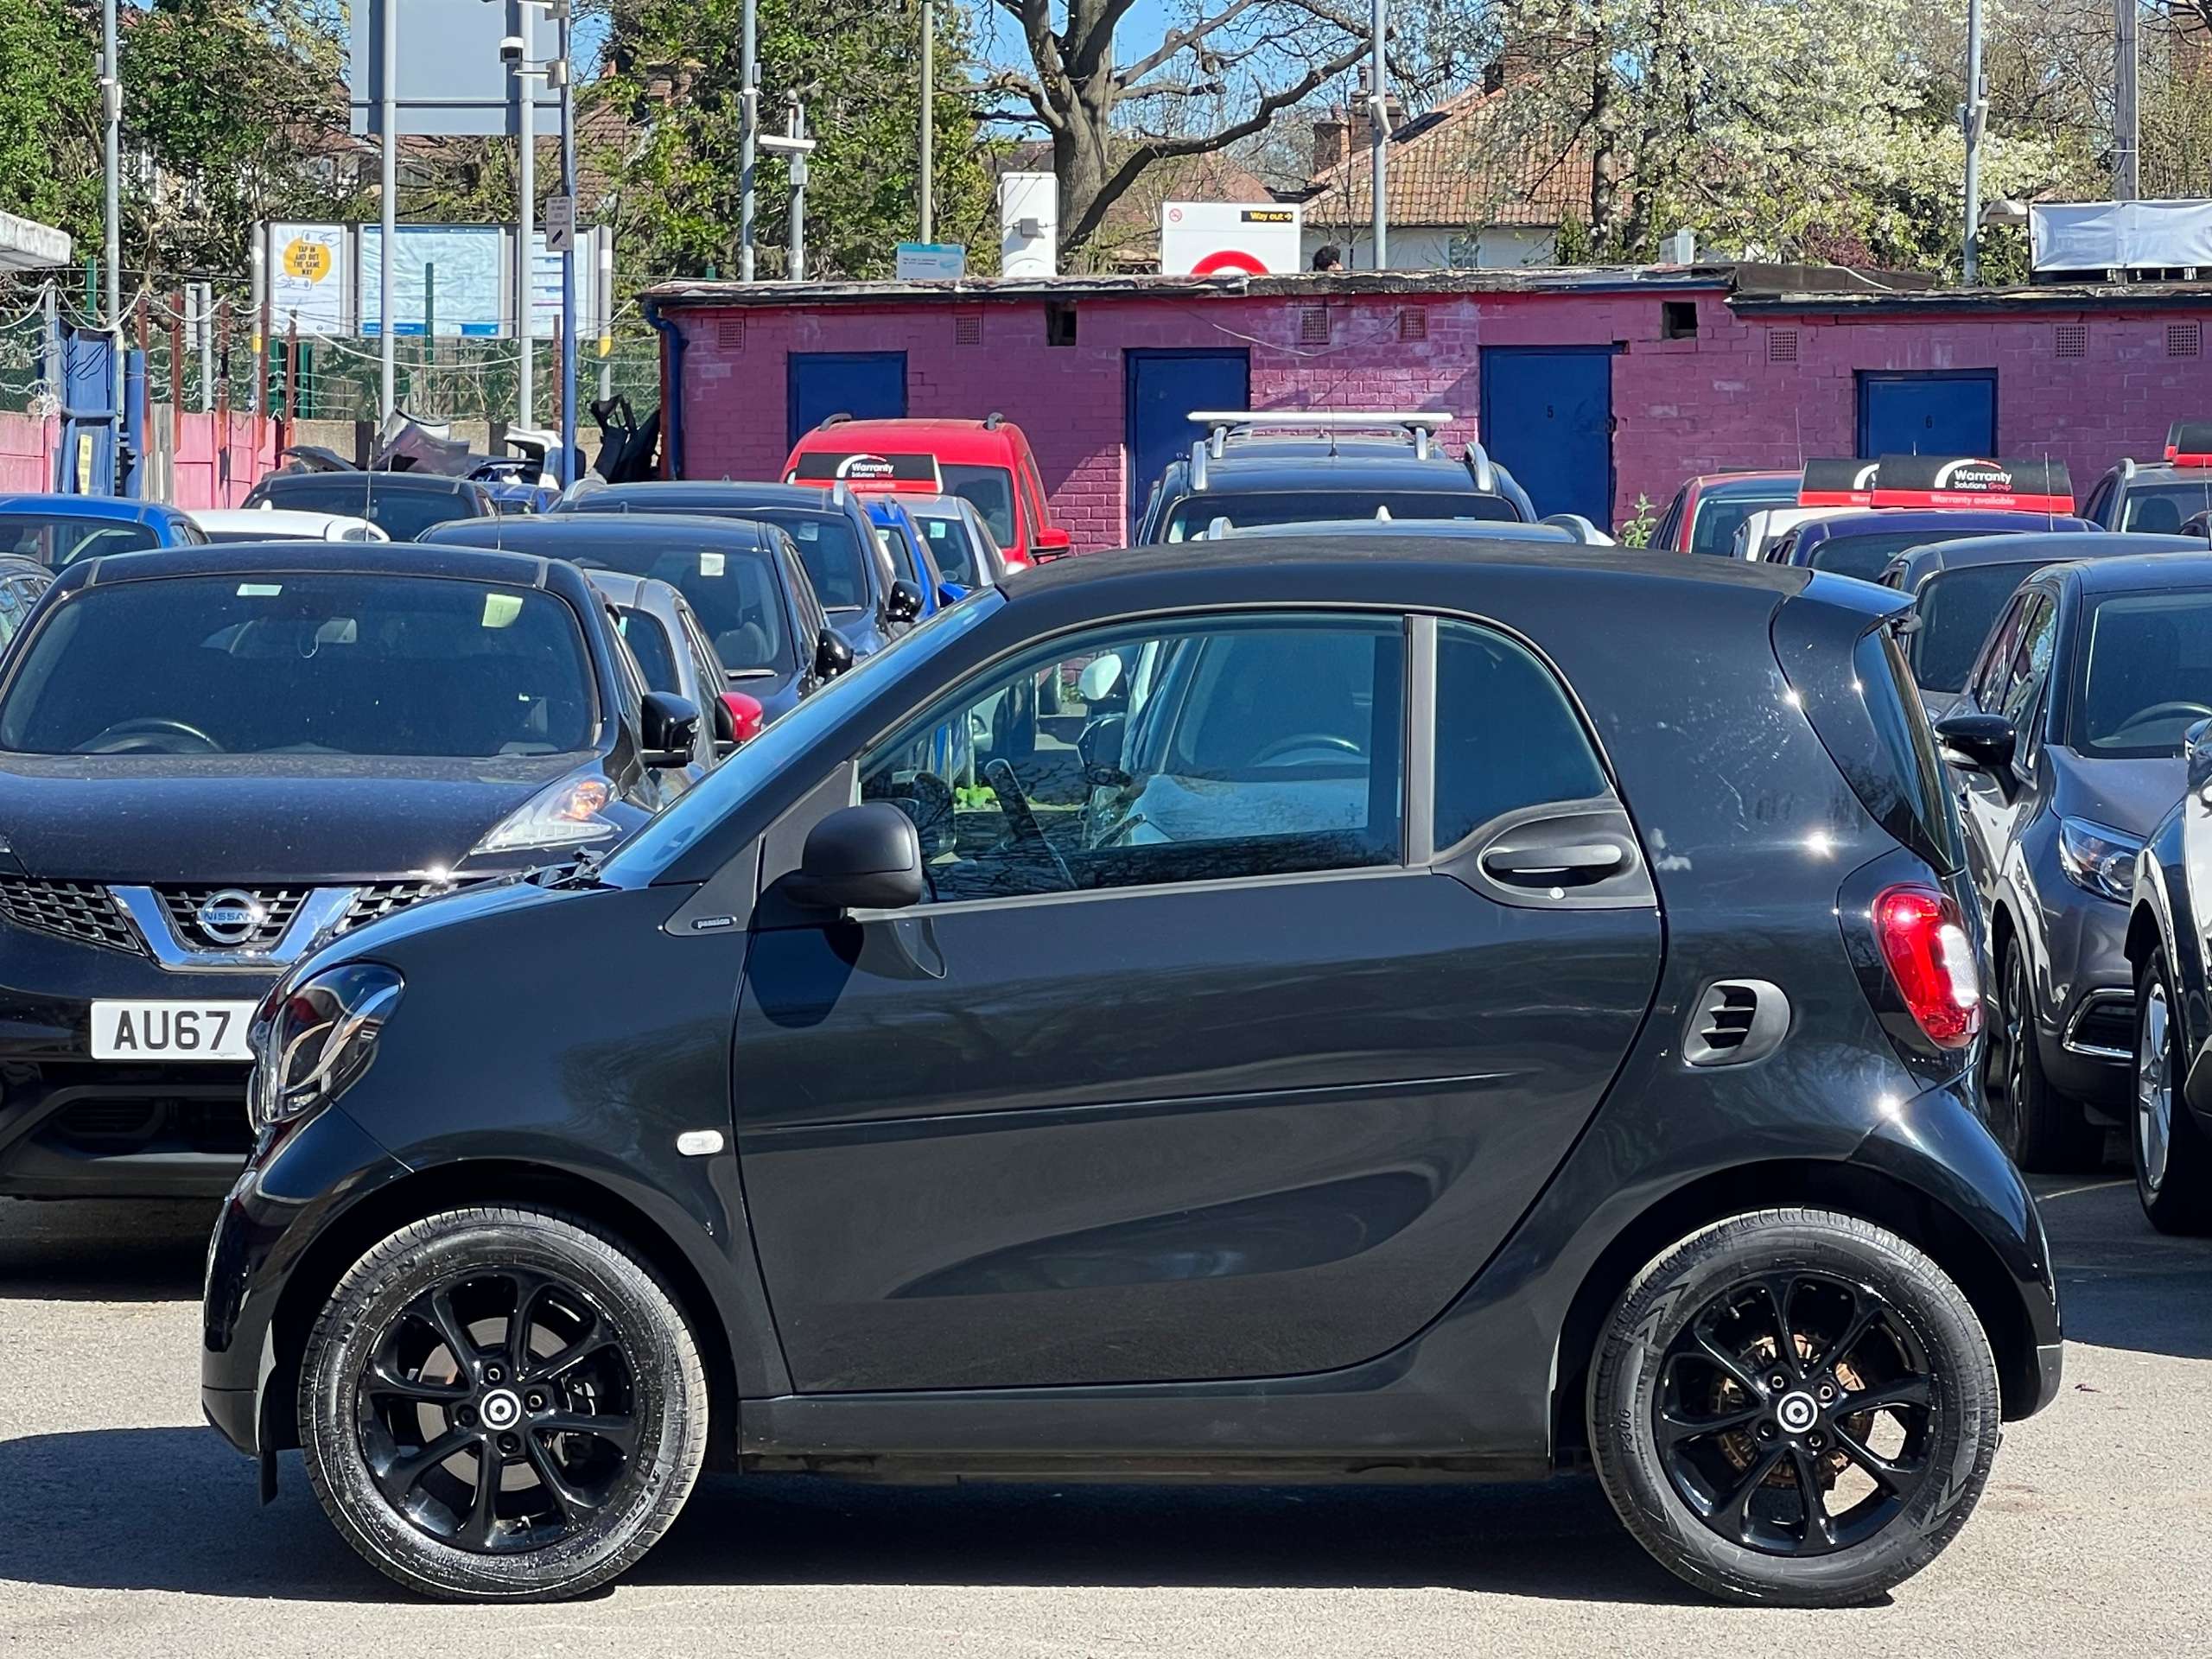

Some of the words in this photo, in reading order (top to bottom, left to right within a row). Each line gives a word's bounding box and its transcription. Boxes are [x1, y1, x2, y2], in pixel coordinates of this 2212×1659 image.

[1250, 212, 1268, 221] Way
[1547, 405, 1554, 418] 5
[1926, 415, 1933, 429] 6
[851, 463, 893, 474] Warranty
[1955, 469, 2012, 485] Warranty
[1955, 480, 1986, 489] Solutions
[1987, 482, 2012, 492] Group
[1930, 494, 1972, 505] Warranty
[1974, 497, 2016, 505] available
[204, 912, 256, 921] NISSAN
[113, 1010, 231, 1050] AU67
